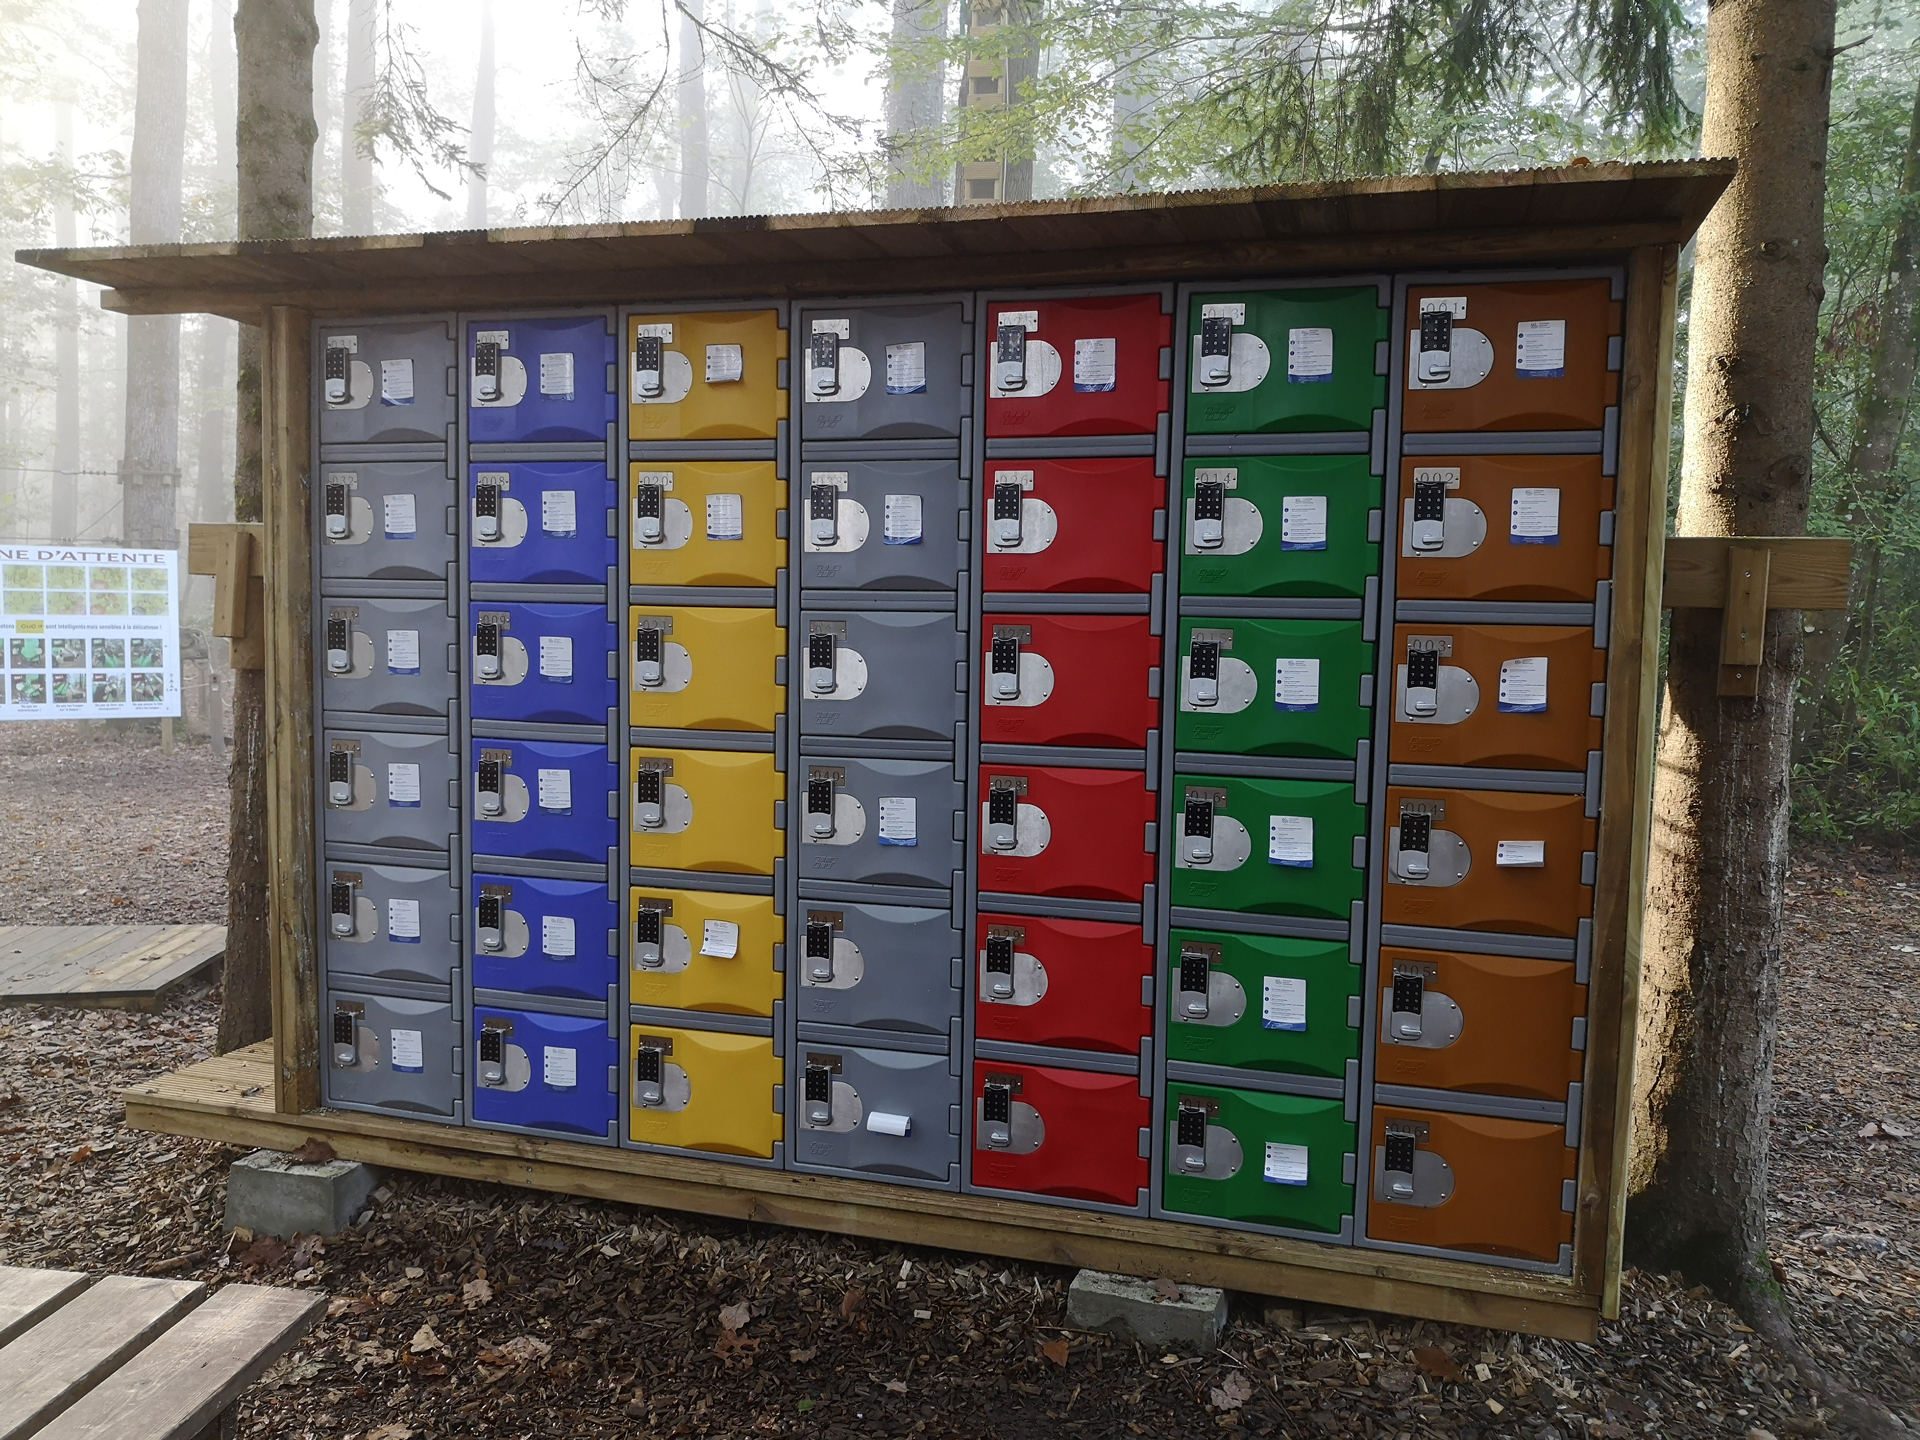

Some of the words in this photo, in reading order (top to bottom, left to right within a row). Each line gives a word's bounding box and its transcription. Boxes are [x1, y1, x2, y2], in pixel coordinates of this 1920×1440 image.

[1426, 302, 1458, 314] 001
[1209, 309, 1239, 319] 013
[643, 328, 667, 338] 019
[482, 335, 504, 345] 007
[332, 476, 354, 486] 032
[482, 476, 505, 486] 008
[644, 476, 668, 487] 020
[817, 476, 842, 486] 038
[1001, 475, 1028, 486] 026
[1201, 473, 1231, 484] 014
[1421, 472, 1454, 483] 002
[38, 550, 165, 564] D'ATTENTE
[483, 615, 506, 625] 009
[643, 619, 665, 629] 021
[998, 629, 1025, 639] 027
[1197, 632, 1227, 644] 015
[1413, 639, 1446, 651] 003
[336, 743, 356, 753] 034
[485, 752, 508, 762] 010
[645, 761, 668, 772] 022
[814, 770, 840, 781] 040
[995, 779, 1022, 791] 028
[1191, 790, 1220, 803] 016
[1406, 802, 1438, 814] 004
[812, 914, 836, 925] 041
[994, 929, 1020, 940] 029
[1187, 946, 1216, 959] 017
[1399, 964, 1431, 977] 005
[990, 1076, 1016, 1088] 030
[1185, 1099, 1213, 1112] 018
[1391, 1123, 1422, 1137] 006
